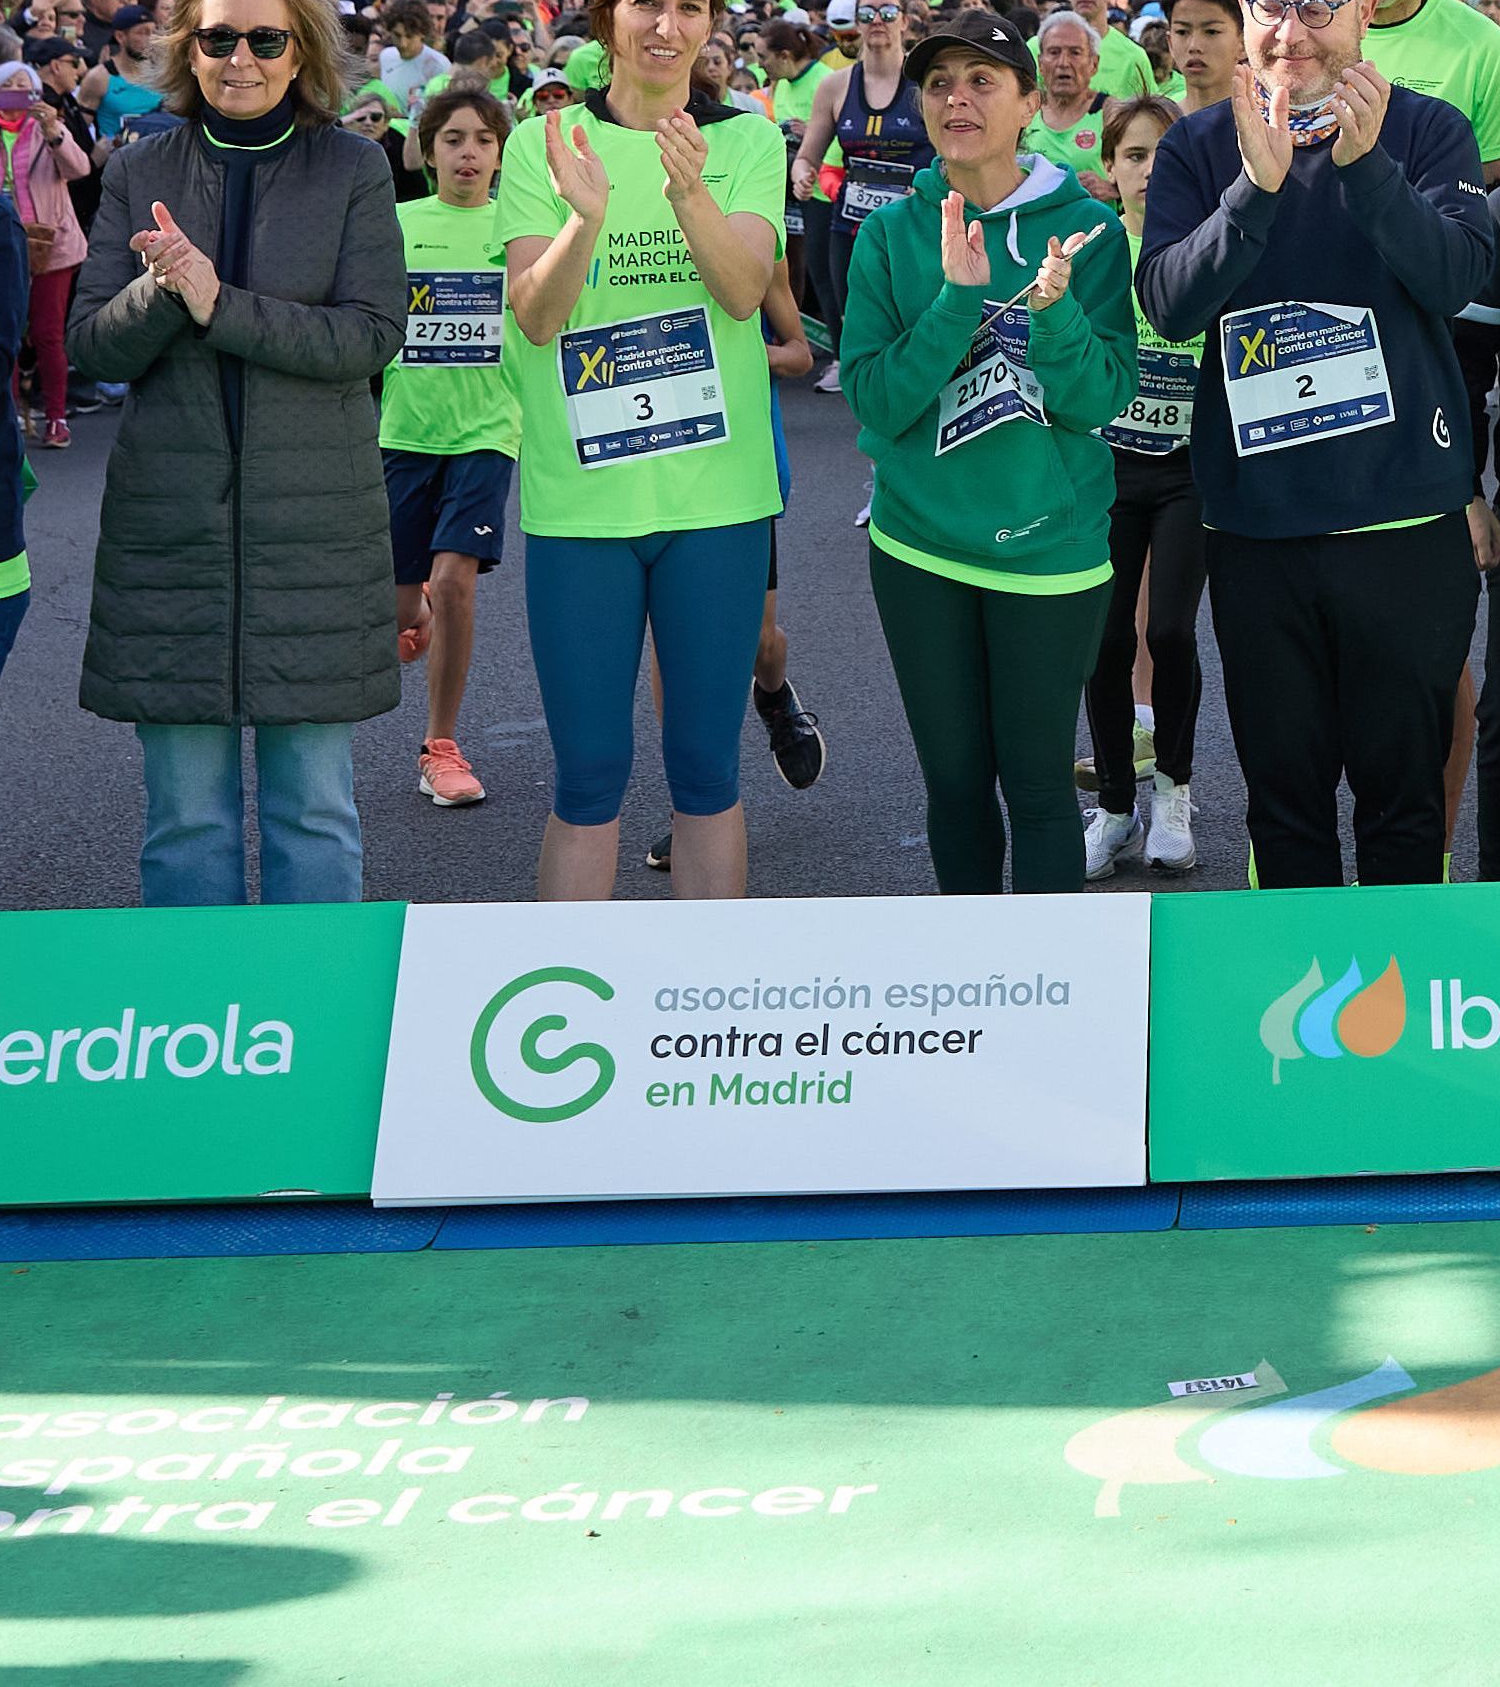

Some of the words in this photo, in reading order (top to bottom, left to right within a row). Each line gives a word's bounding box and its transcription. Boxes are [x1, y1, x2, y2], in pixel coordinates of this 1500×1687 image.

[855, 189, 892, 209] 8797
[608, 229, 684, 249] MADRID
[609, 249, 693, 269] MARCHA
[609, 273, 667, 286] CONTRA
[669, 272, 686, 284] EL
[408, 284, 436, 314] XII
[415, 322, 486, 342] 27394
[972, 334, 996, 354] contra
[1275, 333, 1306, 345] Madrid
[1319, 322, 1352, 336] marcha
[1278, 342, 1314, 355] contra
[1315, 336, 1328, 348] el
[1329, 328, 1367, 344] cáncer
[615, 350, 646, 362] Madrid
[658, 342, 691, 355] marcha
[616, 360, 653, 373] contra
[654, 355, 665, 366] el
[665, 348, 705, 364] cáncer
[1238, 328, 1276, 375] XII
[576, 345, 616, 391] XII
[1162, 375, 1187, 383] marcha
[957, 361, 1022, 408] 21703
[1167, 381, 1196, 392] cáncer
[1295, 374, 1317, 399] 2
[633, 393, 654, 421] 3
[653, 974, 876, 1015] asociación
[885, 971, 1072, 1020] española
[649, 1021, 789, 1062] contra
[796, 1020, 831, 1058] el
[838, 1017, 985, 1058] cáncer
[645, 1078, 699, 1109] en
[708, 1068, 855, 1108] Madrid
[310, 1485, 426, 1531] el
[484, 1474, 887, 1528] cáncer
